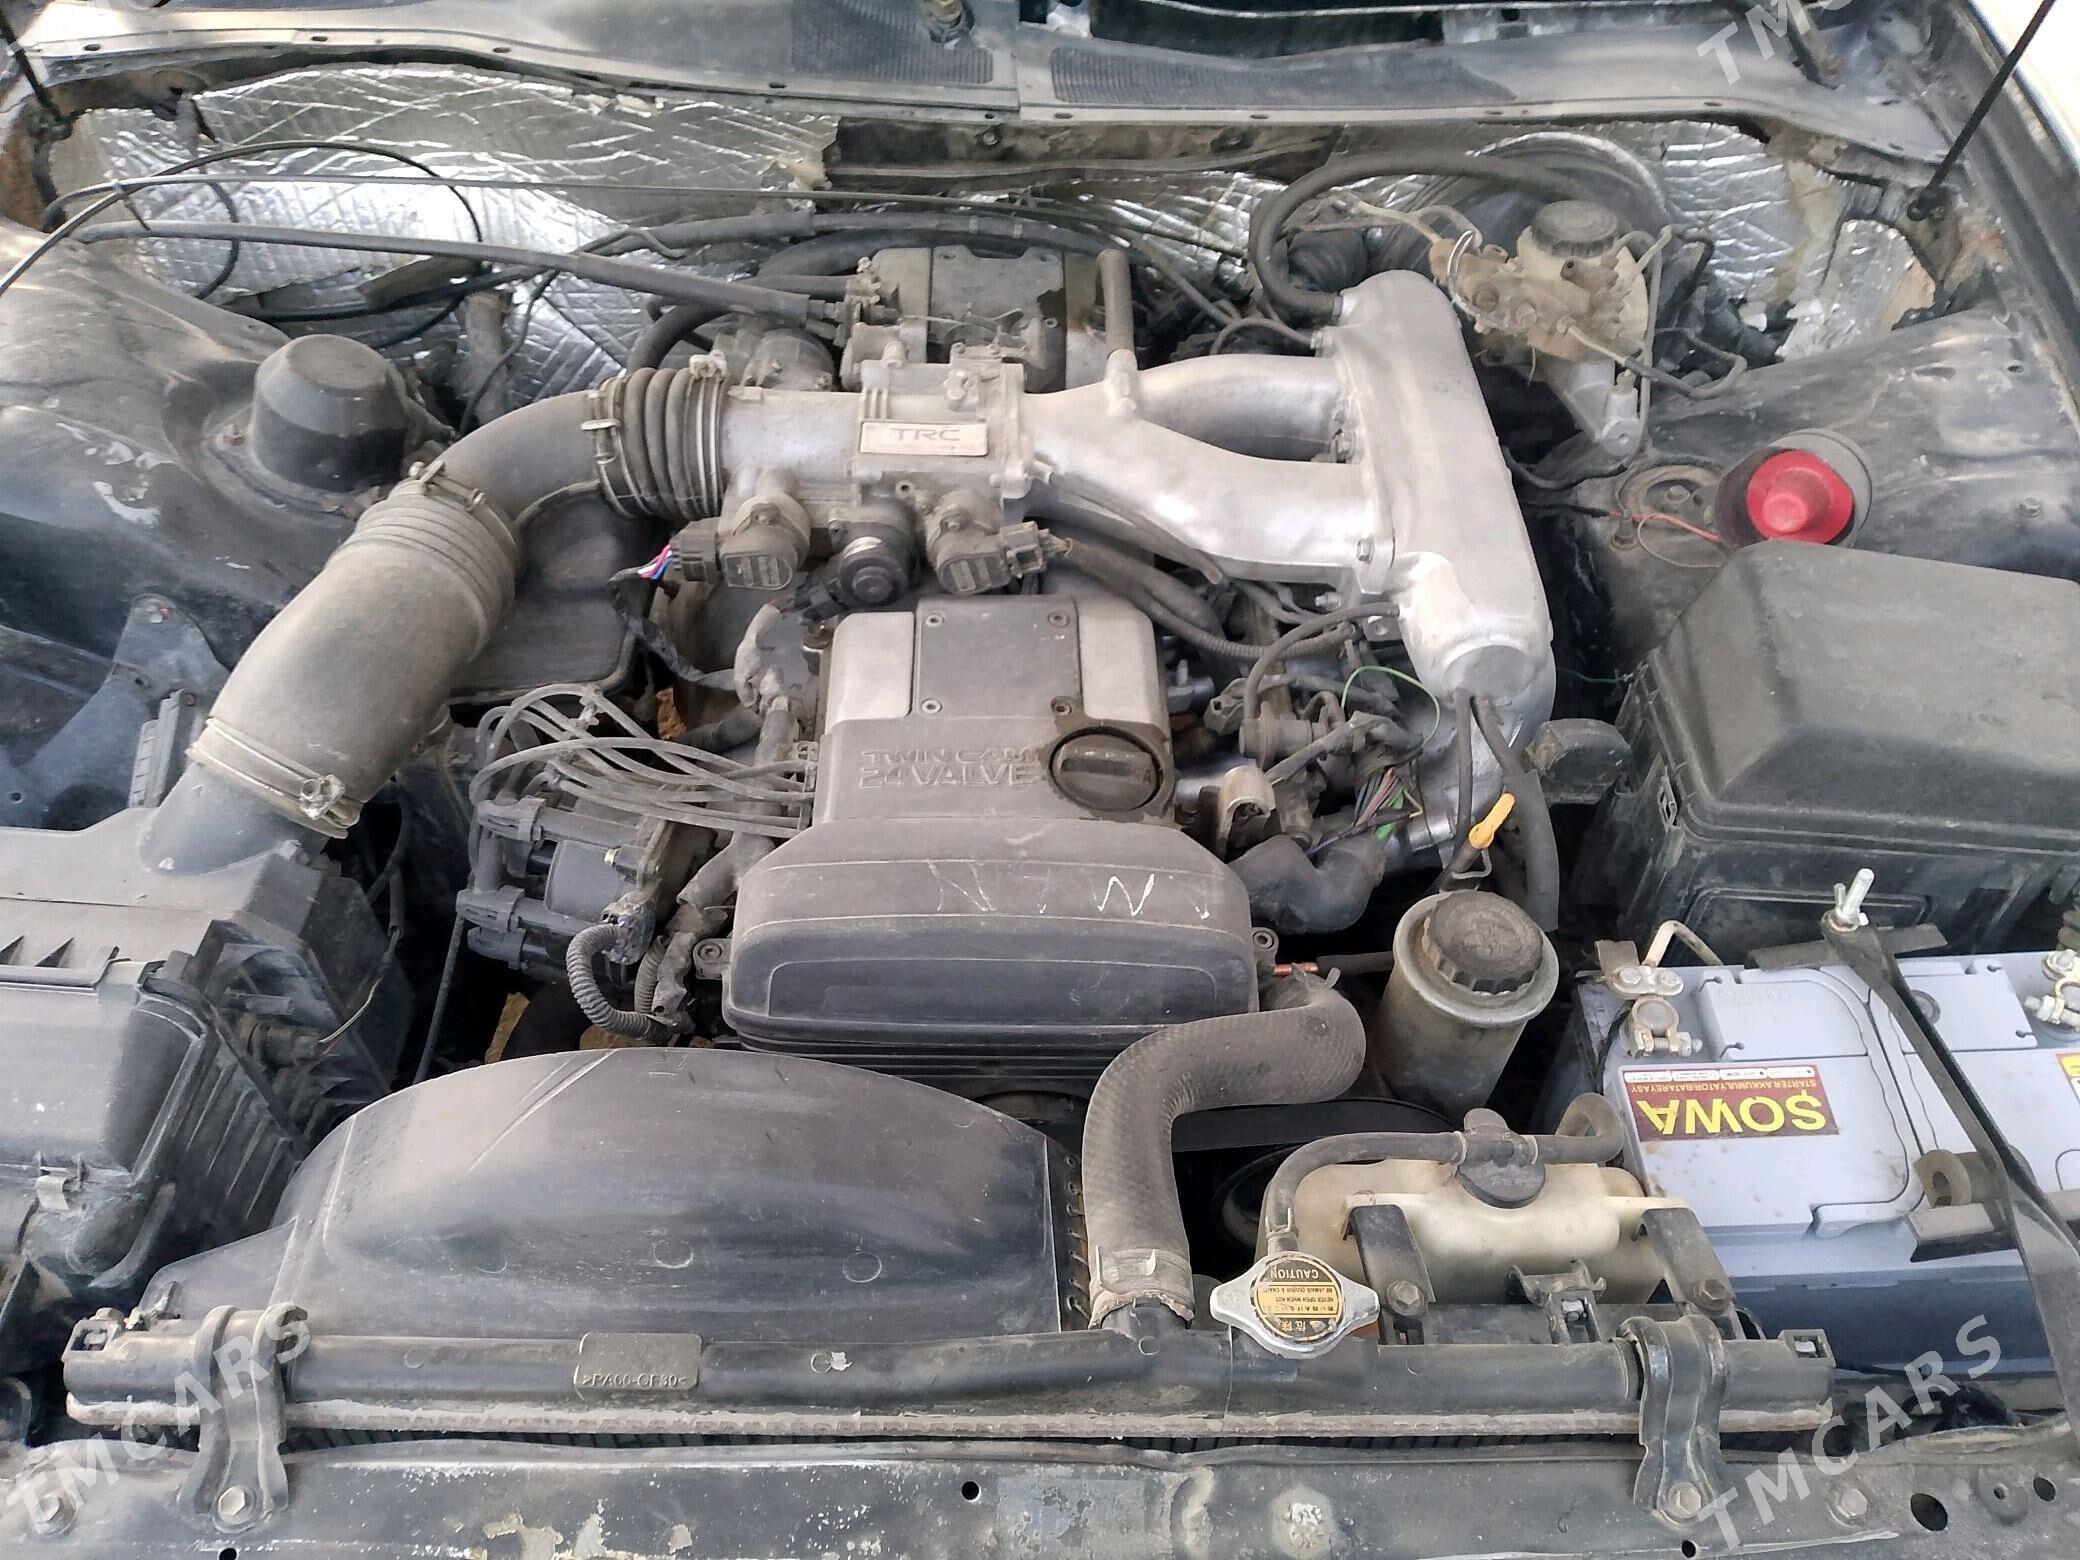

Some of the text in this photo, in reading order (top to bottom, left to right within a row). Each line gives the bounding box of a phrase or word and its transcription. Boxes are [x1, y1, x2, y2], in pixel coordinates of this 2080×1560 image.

[890, 428, 961, 442] TRC
[861, 747, 1037, 764] TWIN CAM
[910, 764, 1035, 788] VALVE
[1775, 1079, 1817, 1089] STARTER
[1270, 1269, 1319, 1279] CAUTION
